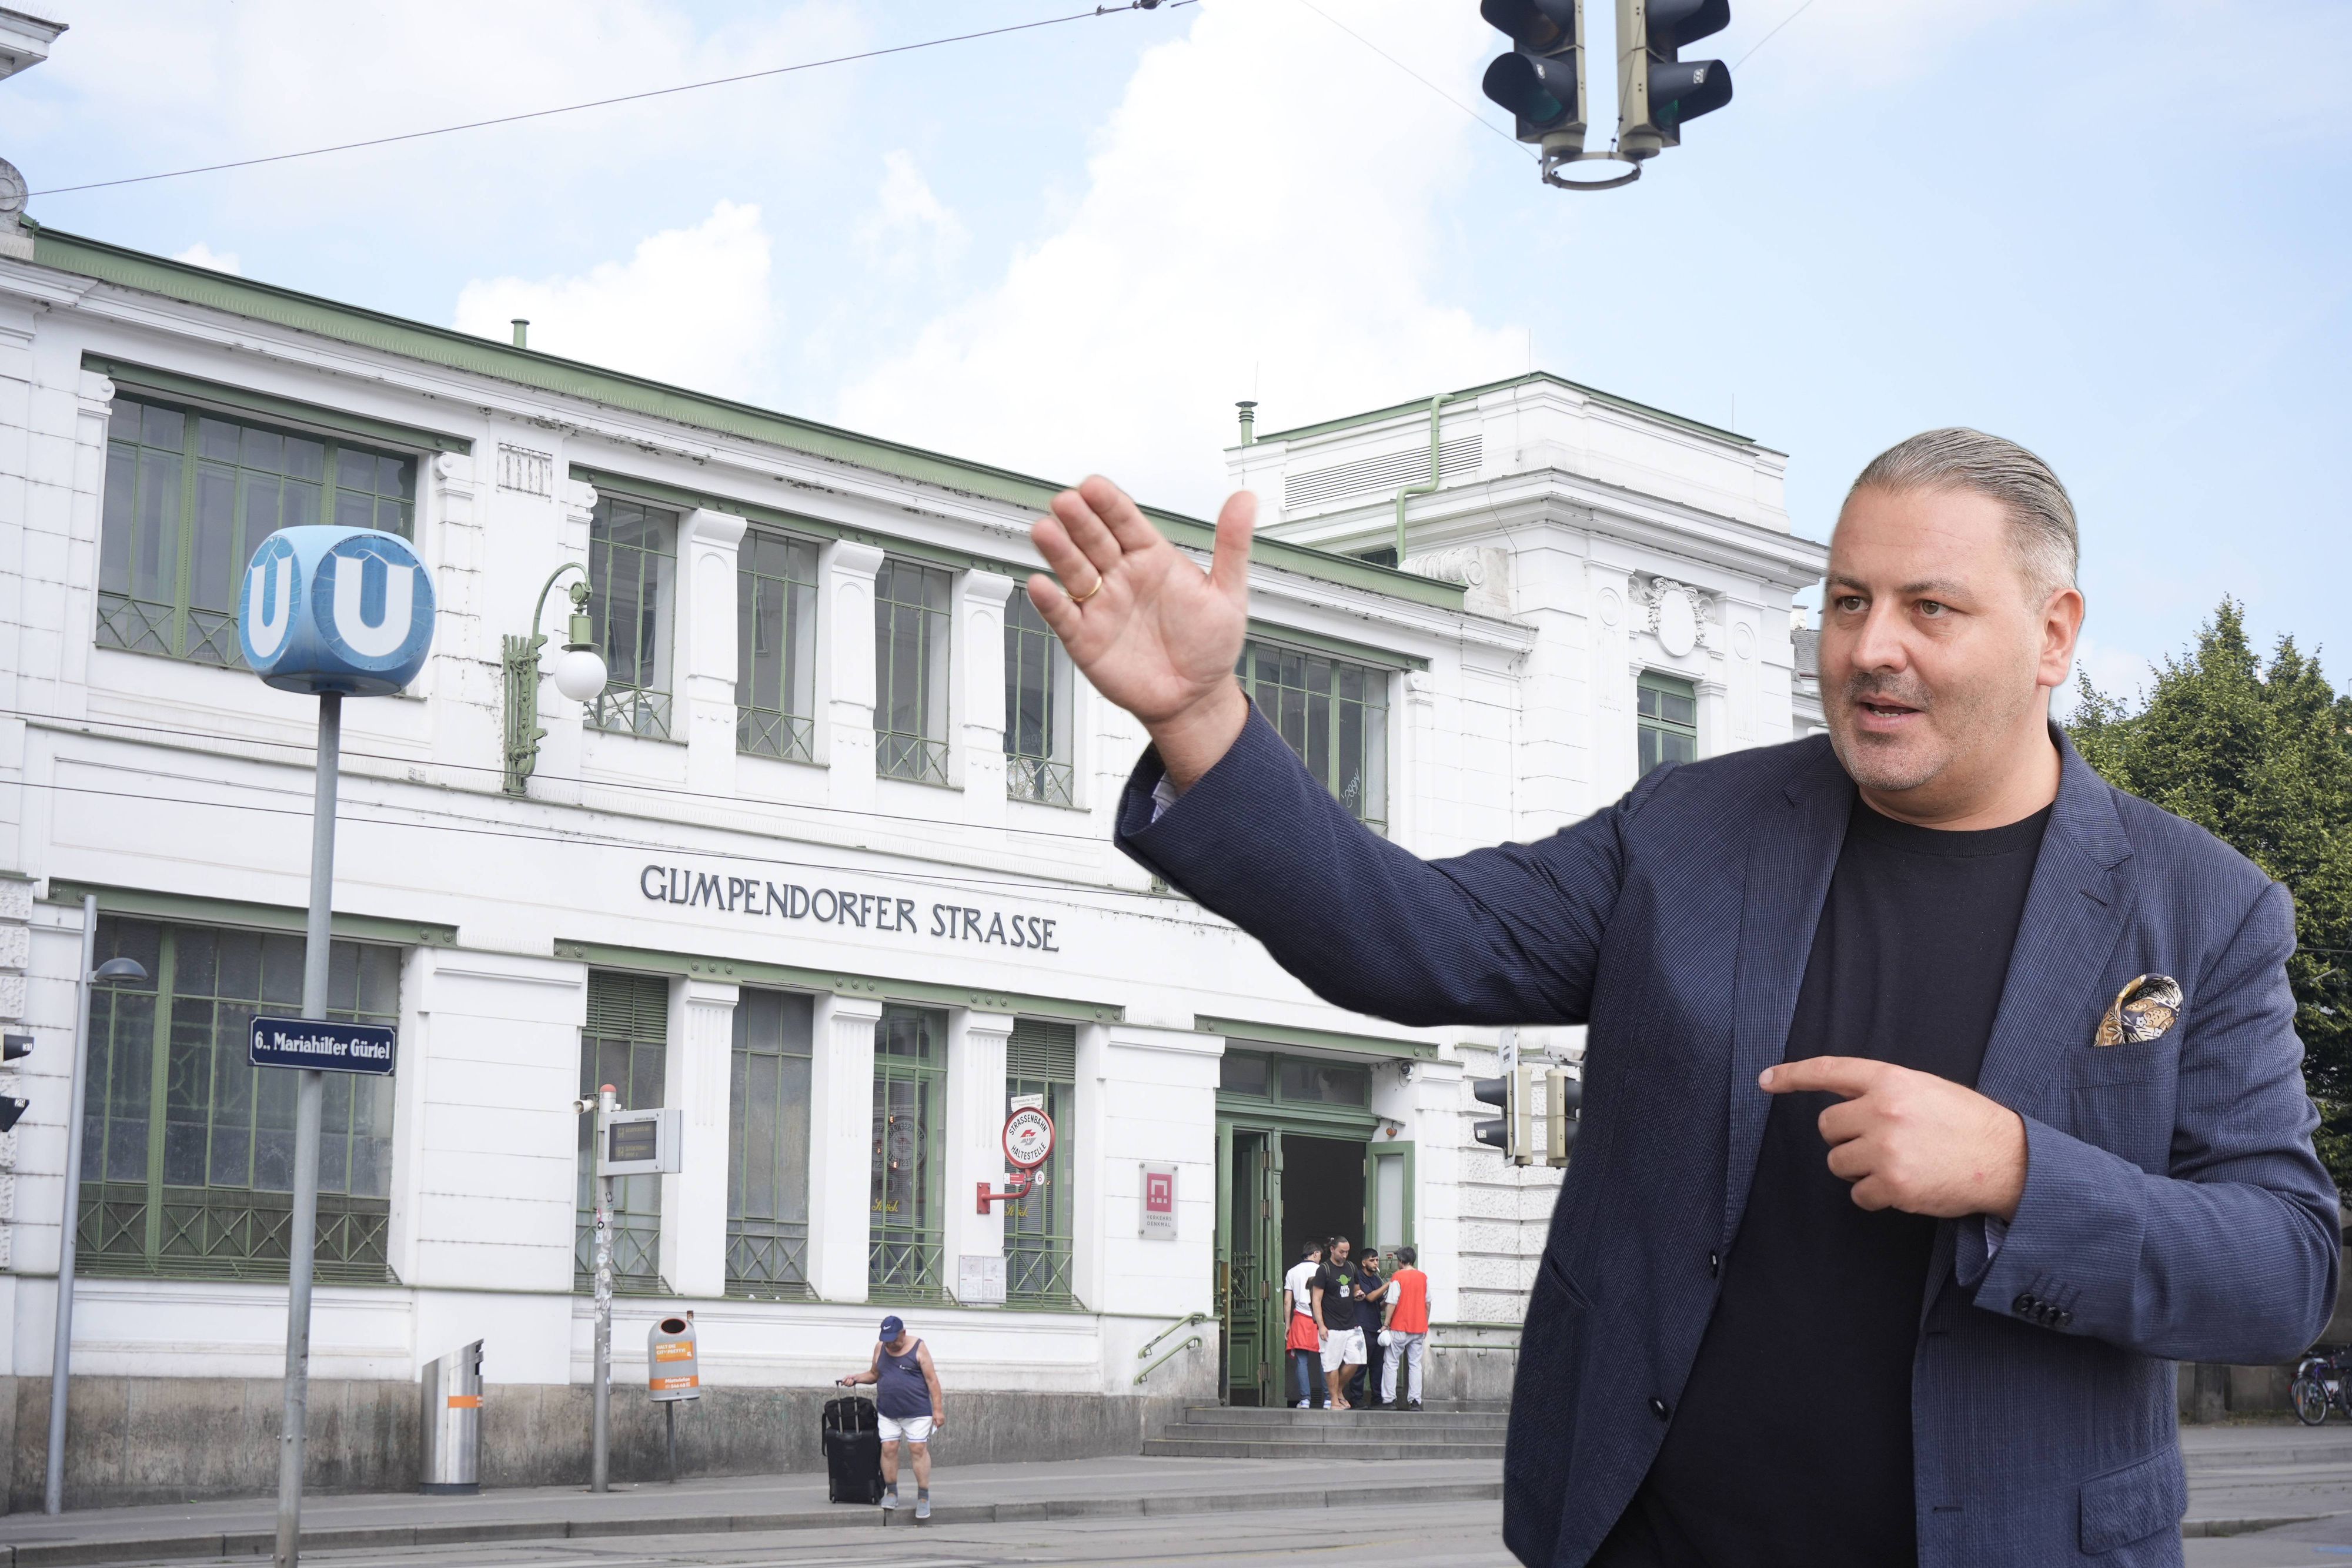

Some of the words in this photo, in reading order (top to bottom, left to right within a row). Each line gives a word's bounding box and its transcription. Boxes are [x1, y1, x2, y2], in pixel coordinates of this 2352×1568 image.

[249, 556, 292, 658] U
[333, 556, 414, 657] U
[640, 864, 917, 933] GUMPENDORFER
[930, 903, 1060, 952] STRASSE
[273, 1032, 348, 1056] Mariahilfer
[350, 1038, 390, 1059] Gürtel
[15, 1099, 25, 1107] 29
[1009, 1114, 1048, 1135] STRASSENBAHN
[1011, 1142, 1047, 1160] HALTESTELLE
[871, 1198, 900, 1212] Stöck
